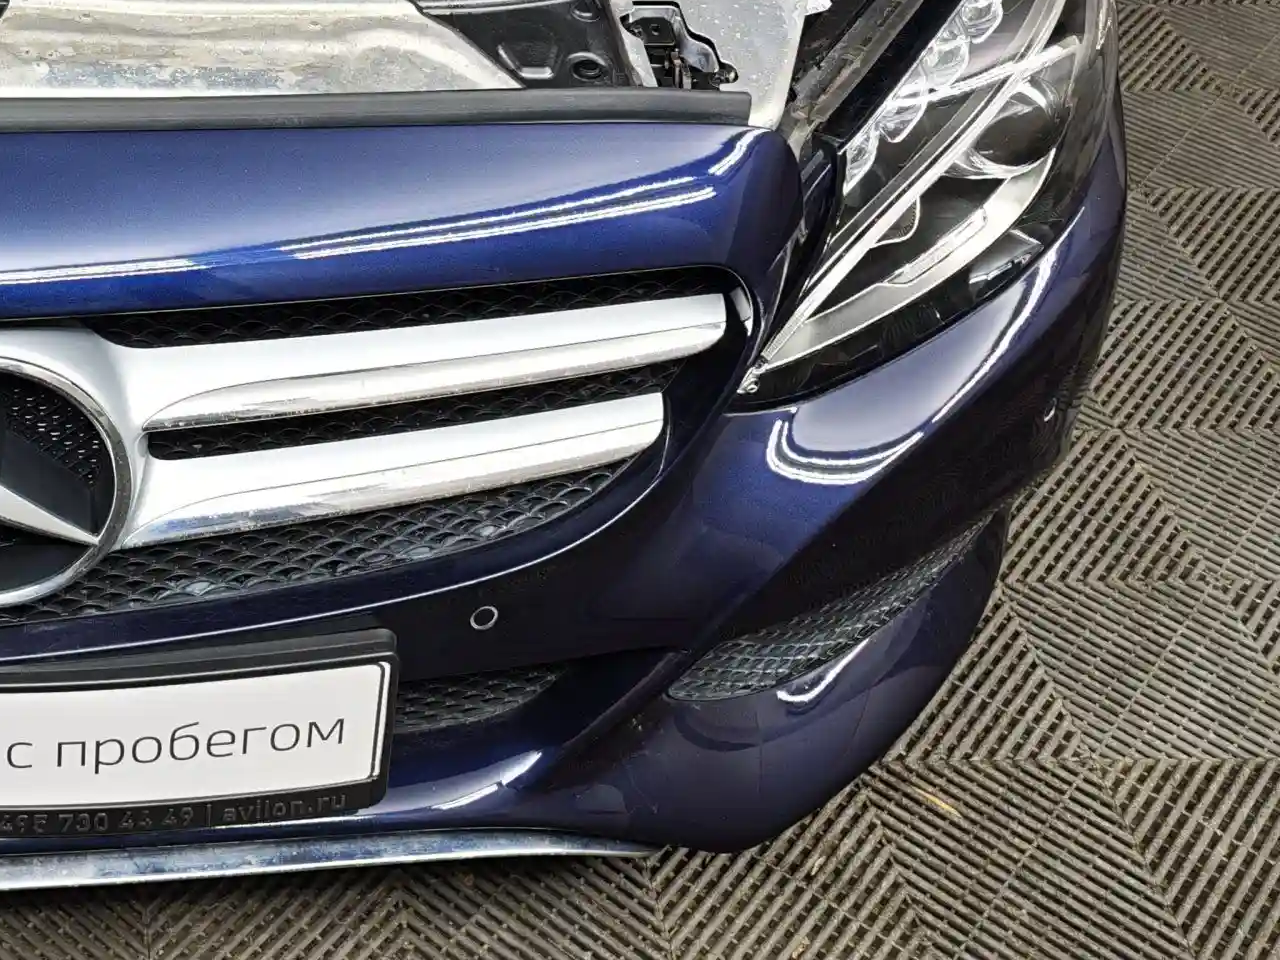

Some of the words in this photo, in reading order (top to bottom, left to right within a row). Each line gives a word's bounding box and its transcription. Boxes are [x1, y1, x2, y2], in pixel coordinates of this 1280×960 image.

[6, 741, 33, 769] с
[56, 718, 346, 775] пробегом
[58, 811, 110, 833] 730
[221, 793, 348, 822] avilon.ru
